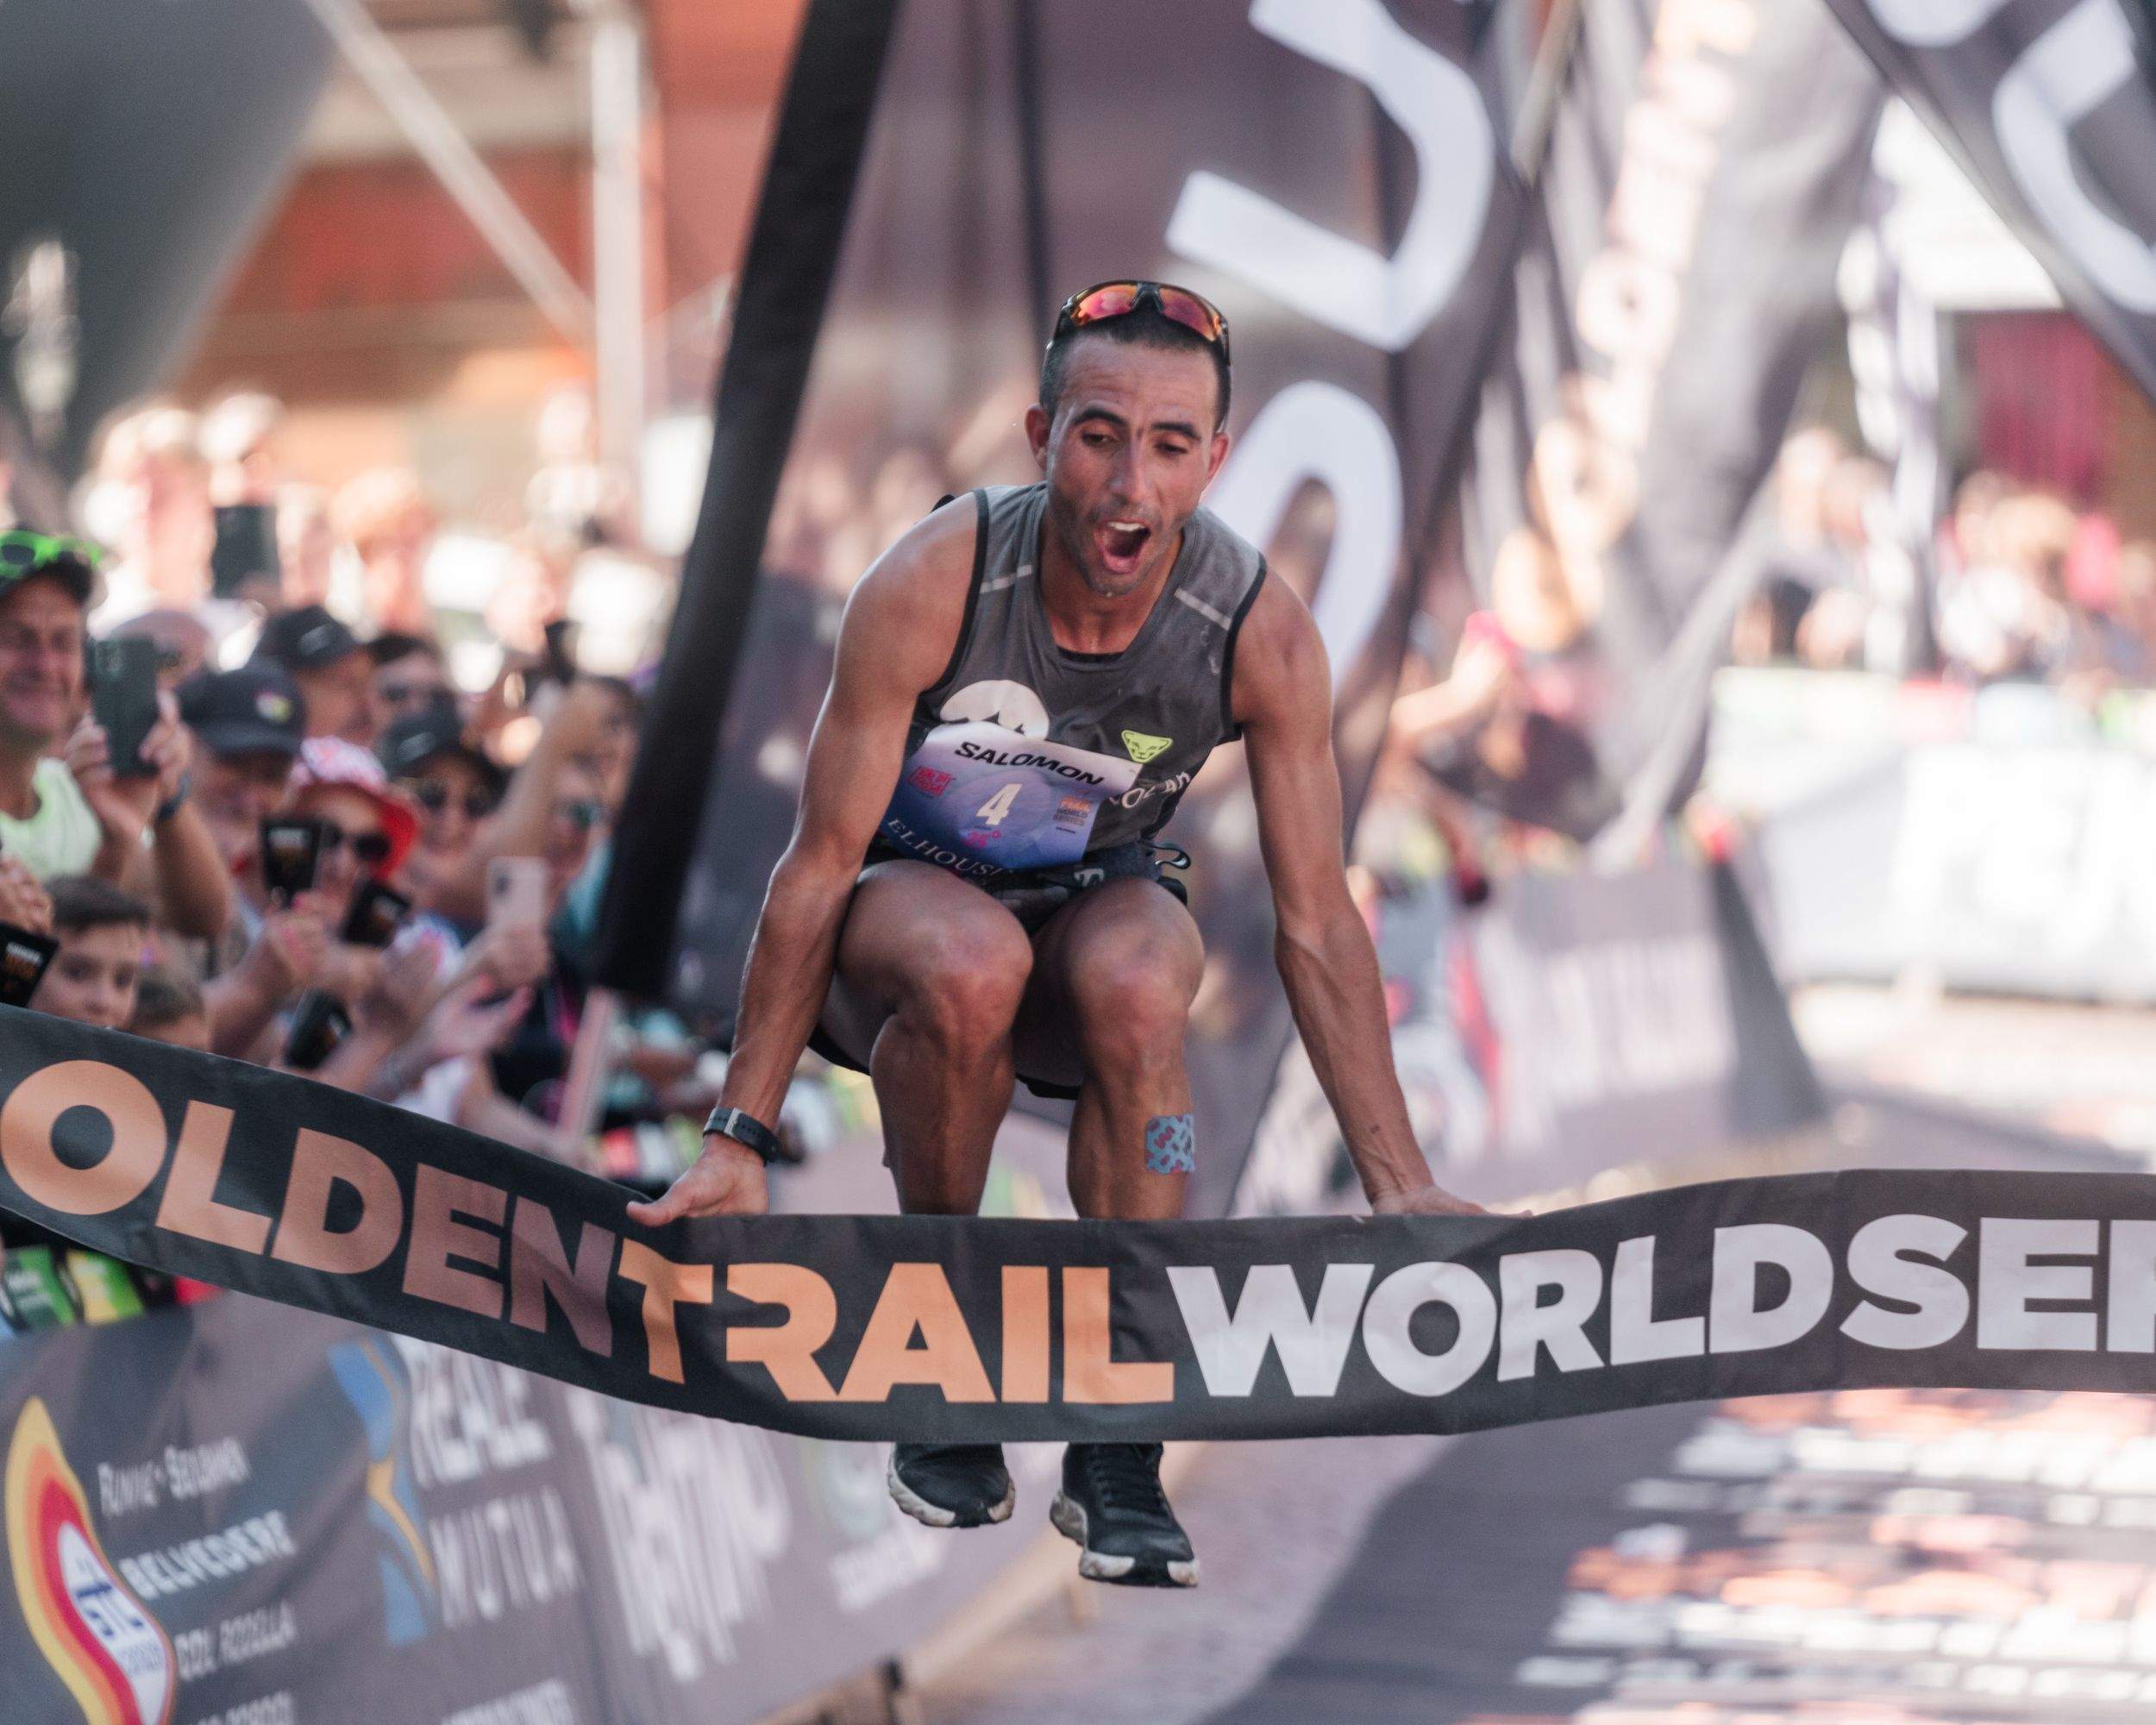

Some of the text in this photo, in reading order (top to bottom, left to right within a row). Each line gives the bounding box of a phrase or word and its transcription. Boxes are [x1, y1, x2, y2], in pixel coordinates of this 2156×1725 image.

[955, 742, 1105, 786] SALOMON
[975, 783, 1023, 825] 4
[618, 1239, 1175, 1403] TRAIL
[1167, 1214, 1833, 1398] WORLD
[118, 1509, 298, 1601] BELVEDERE
